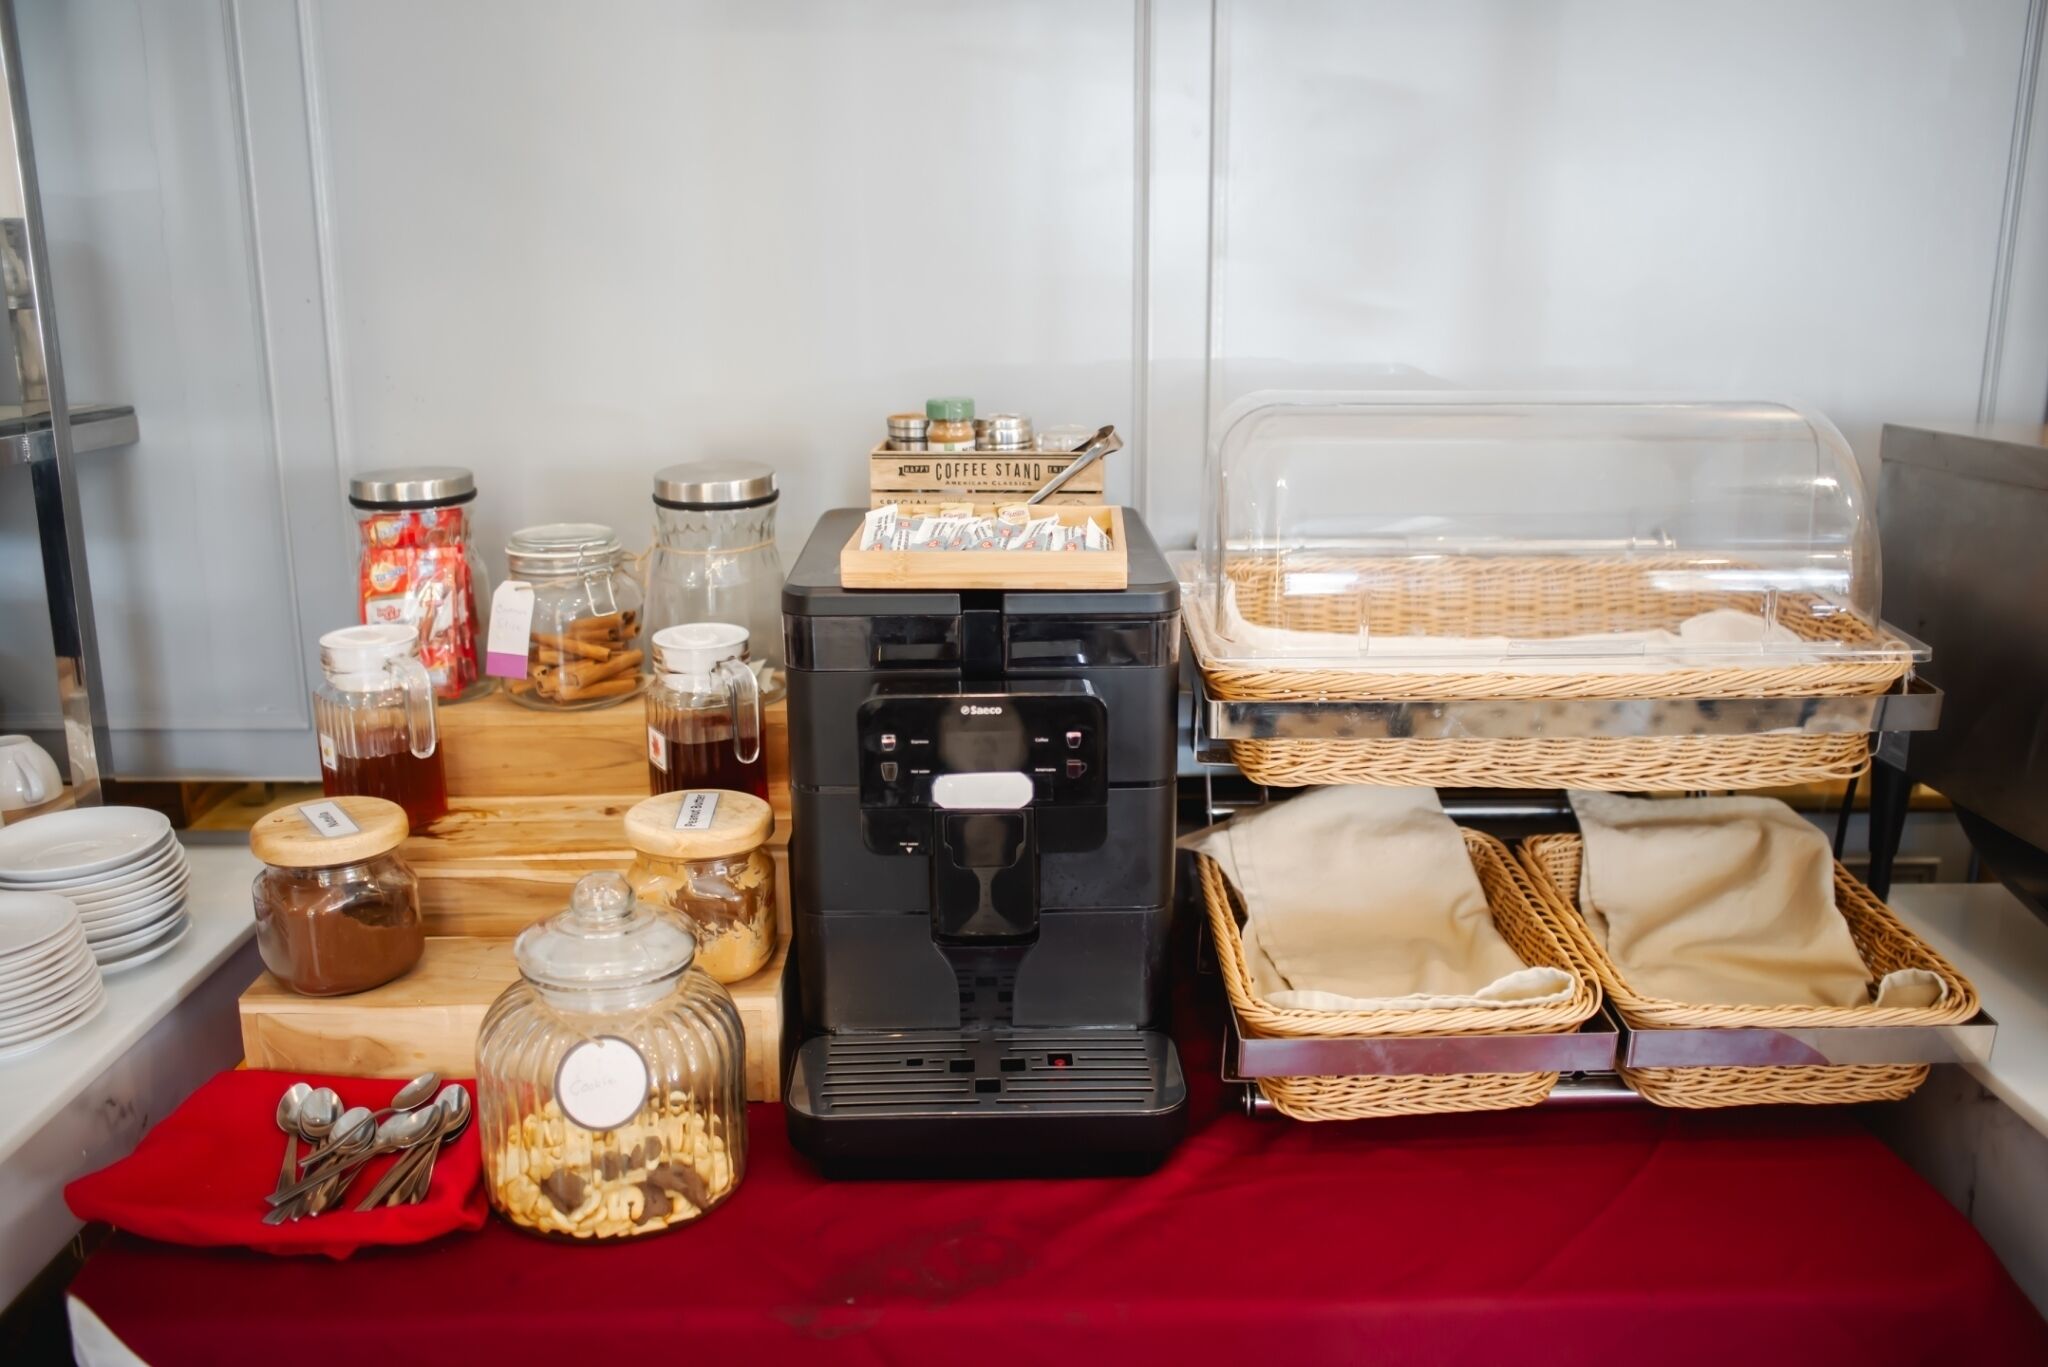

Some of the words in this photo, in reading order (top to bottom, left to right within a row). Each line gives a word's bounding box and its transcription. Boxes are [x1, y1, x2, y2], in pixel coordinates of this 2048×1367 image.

[936, 463, 987, 480] COFFEE
[996, 463, 1041, 481] STAND
[970, 705, 1003, 715] Saeco
